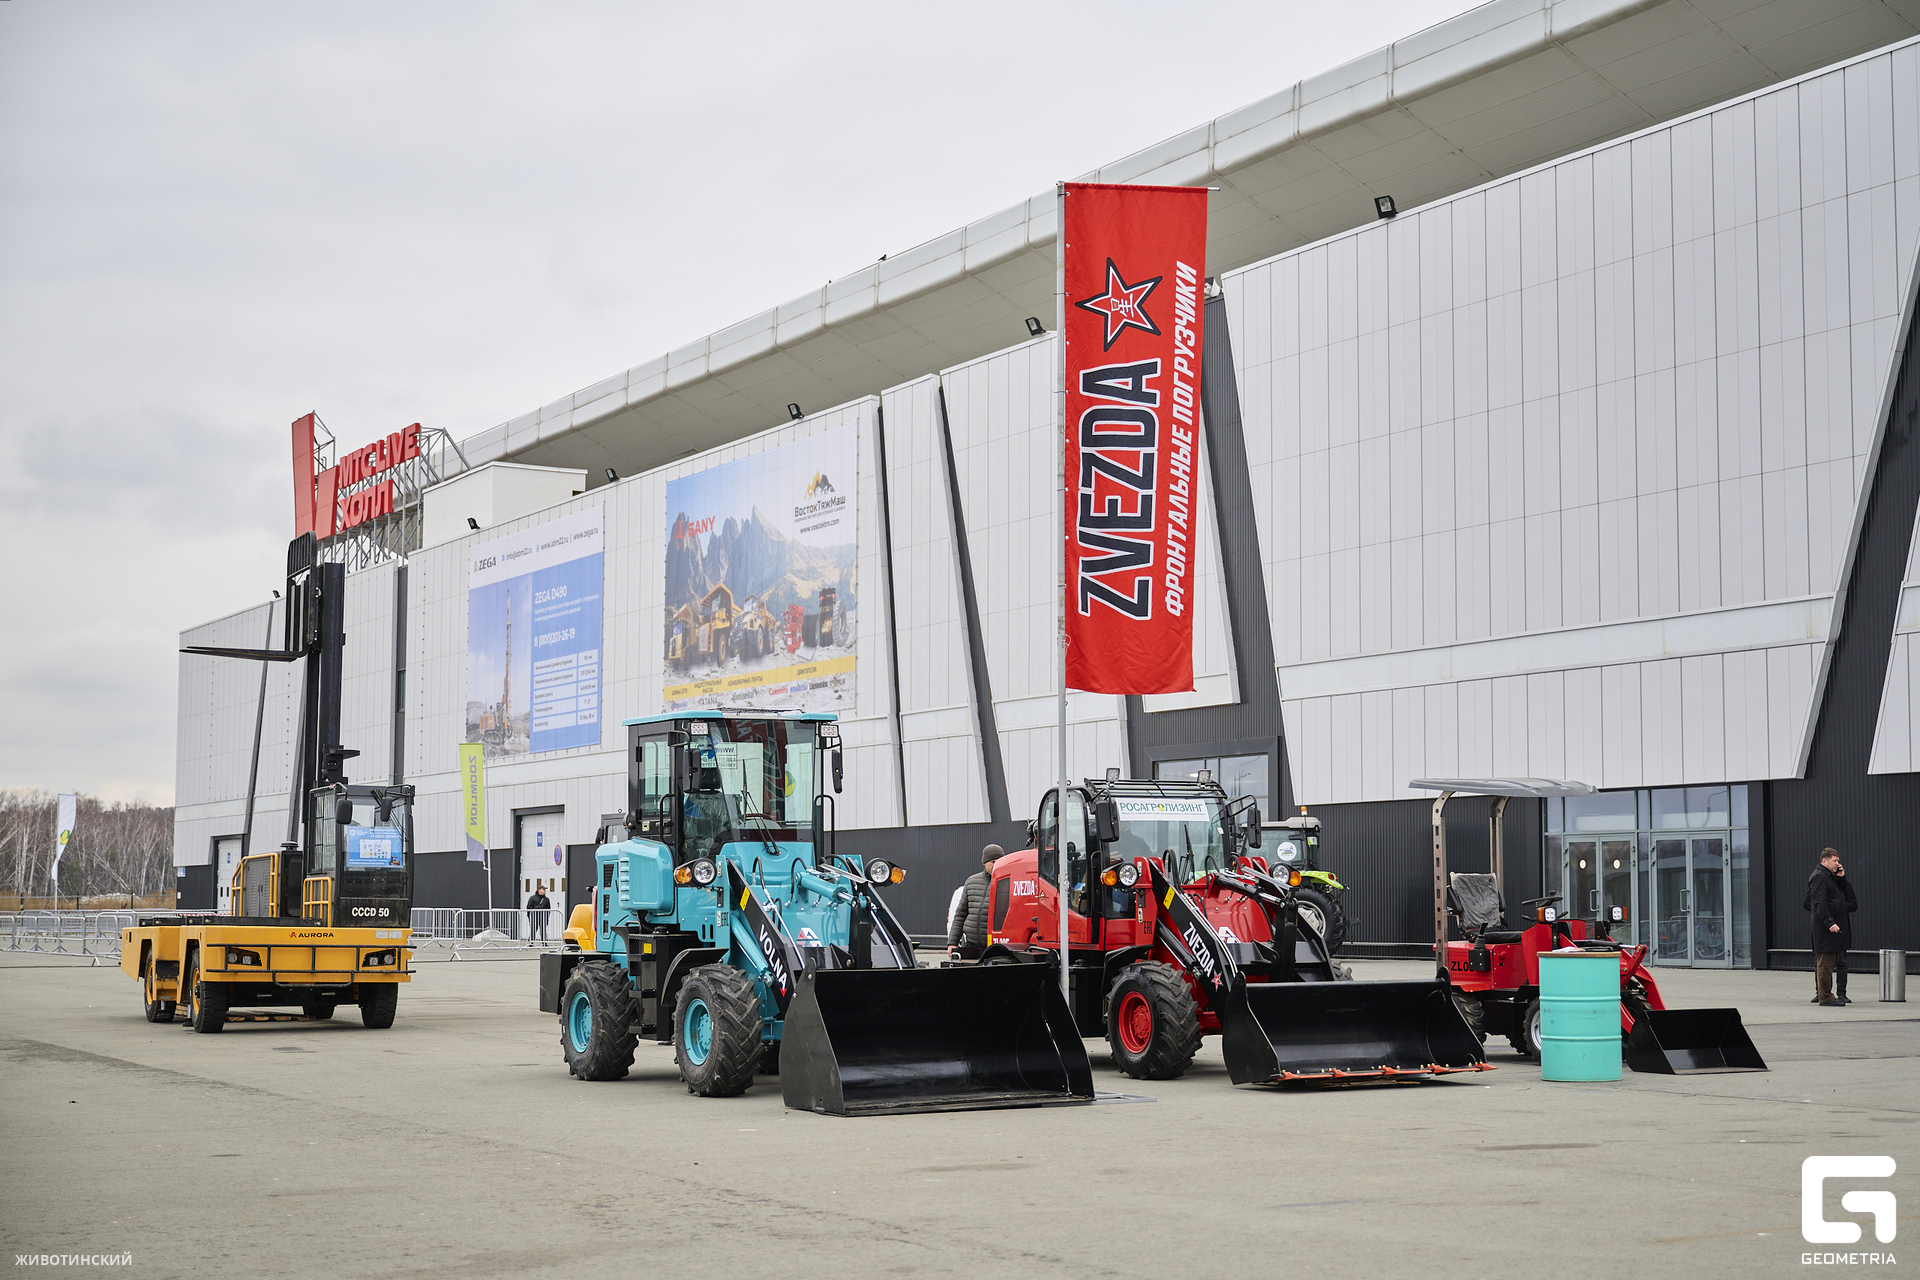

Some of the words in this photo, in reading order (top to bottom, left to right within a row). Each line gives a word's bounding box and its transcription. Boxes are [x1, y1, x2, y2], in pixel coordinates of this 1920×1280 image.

[1172, 261, 1197, 426] ПОГРУЗЧИКИ
[376, 423, 420, 474] LIVE
[1077, 357, 1161, 620] ZVEZDA
[339, 479, 393, 534] ХОЛЛ
[795, 496, 846, 517] ВостокТяжМаш
[687, 516, 715, 537] SANY
[1165, 424, 1193, 617] ФРОНТАЛЬНЫЕ
[573, 527, 598, 541] www.zega.ru
[479, 556, 496, 571] ZEGA
[535, 590, 550, 604] ZEGA
[534, 636, 538, 647] 8
[1120, 802, 1203, 812] РОСАГРОЛИЗИНГ
[1013, 880, 1036, 896] ZVEZDA
[351, 907, 376, 917] CCCD
[378, 907, 390, 917] 50
[759, 924, 788, 990] VOLNA
[1183, 921, 1215, 978] ZVEZDA
[1451, 961, 1474, 972] ZL0
